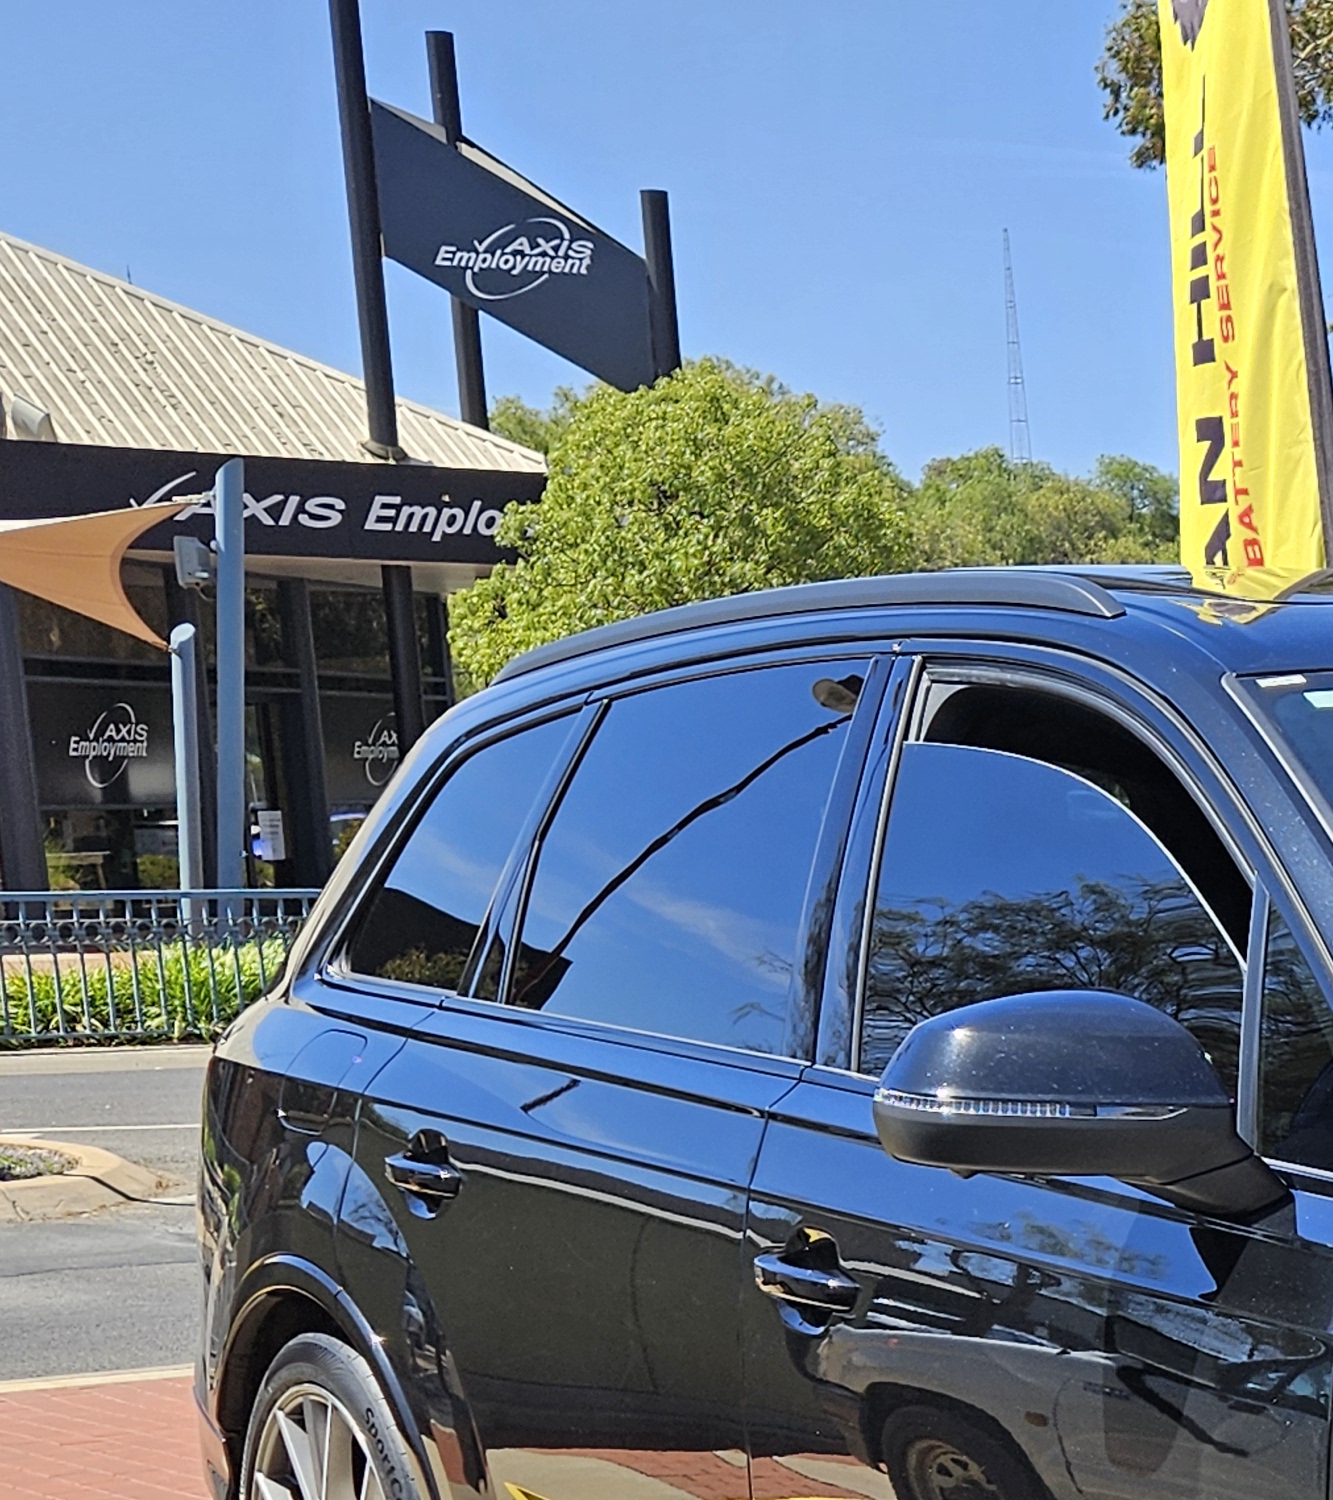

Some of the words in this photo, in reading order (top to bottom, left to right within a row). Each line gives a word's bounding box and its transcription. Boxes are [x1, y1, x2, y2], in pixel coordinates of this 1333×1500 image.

[503, 236, 595, 258] AXIS
[1207, 145, 1235, 343] SERVICE
[434, 245, 592, 276] Employment
[1223, 361, 1265, 568] BATTERY
[364, 495, 499, 541] Emplo
[103, 723, 148, 741] AXIS
[69, 736, 147, 761] Employment
